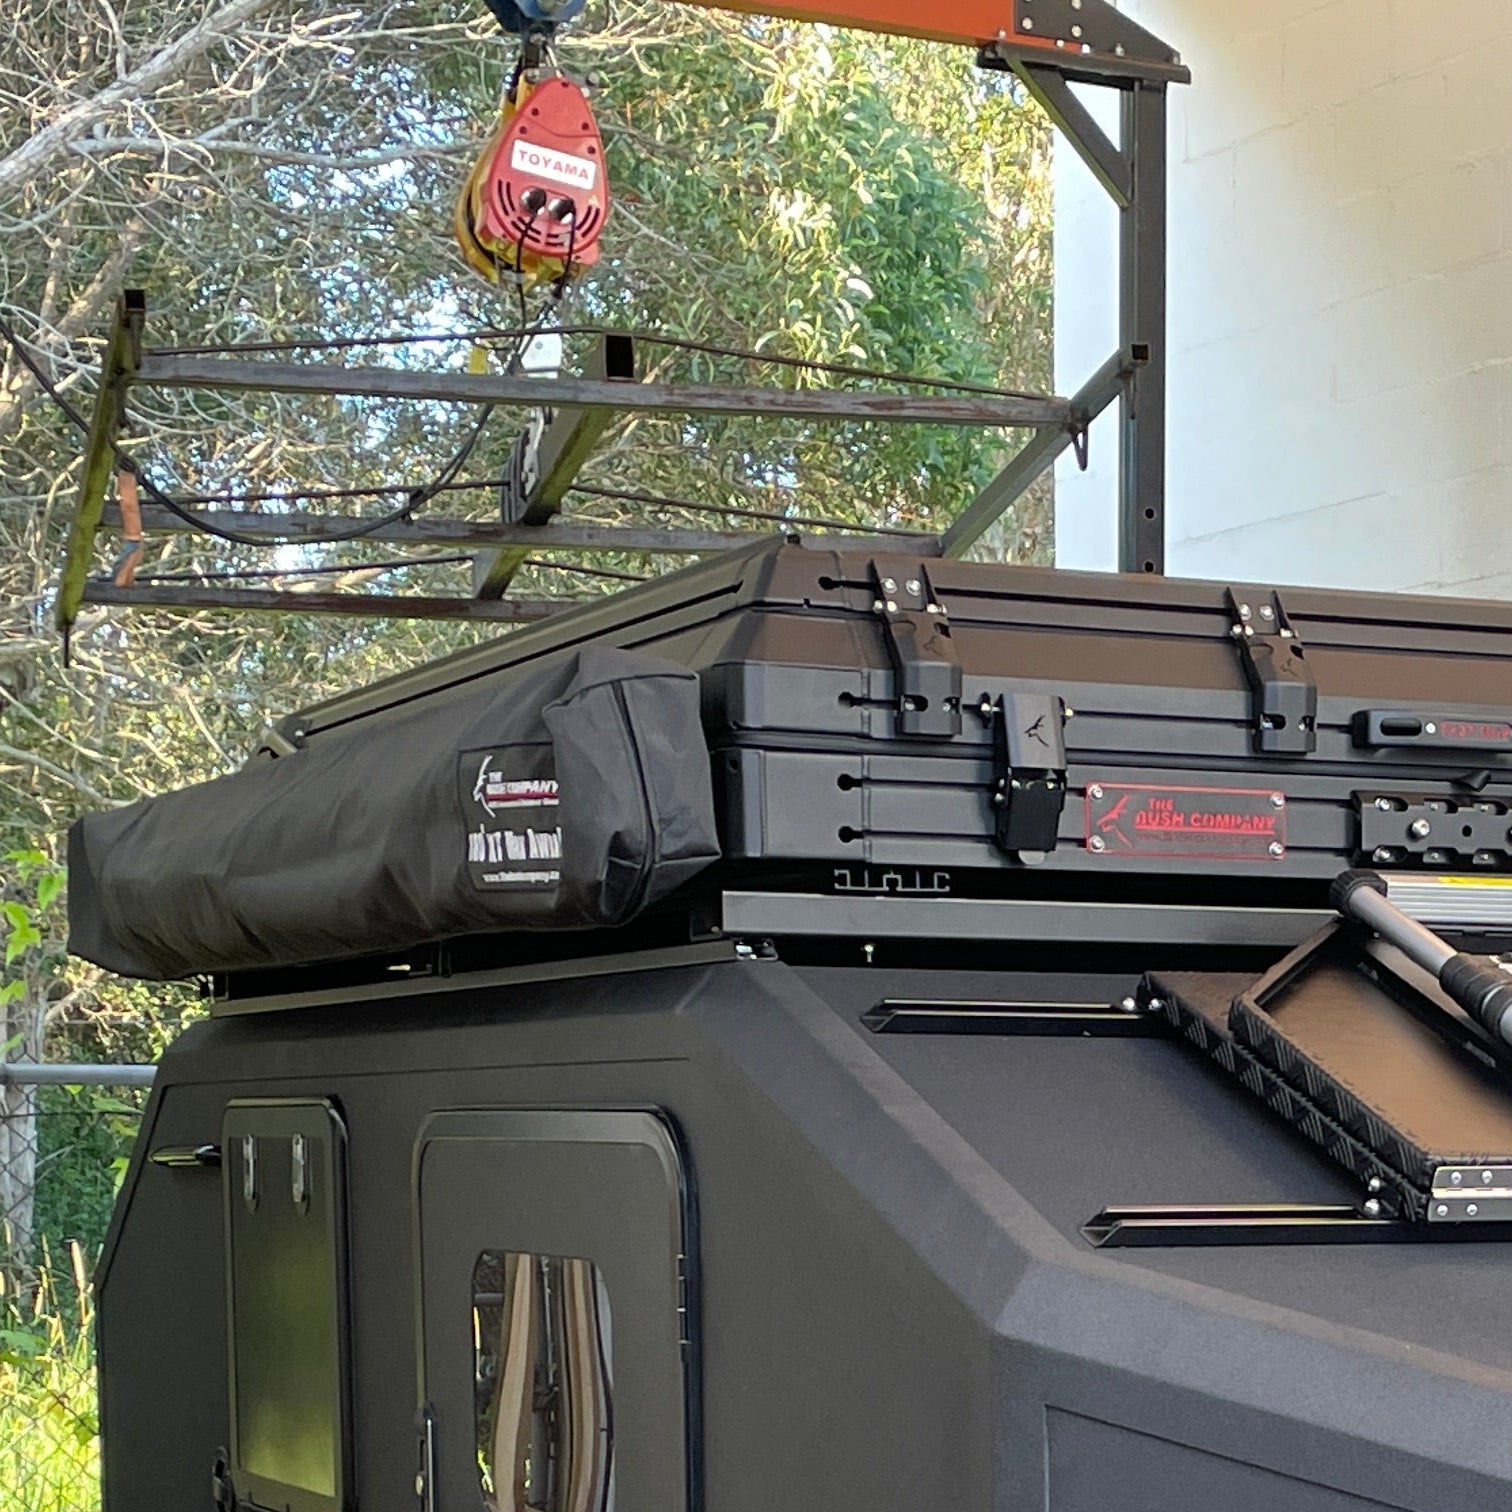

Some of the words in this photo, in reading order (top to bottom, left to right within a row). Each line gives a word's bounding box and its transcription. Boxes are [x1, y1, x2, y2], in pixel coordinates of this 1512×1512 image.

[519, 150, 589, 180] TOYAMA
[1148, 798, 1174, 811] THE
[1190, 812, 1276, 831] COMPANY
